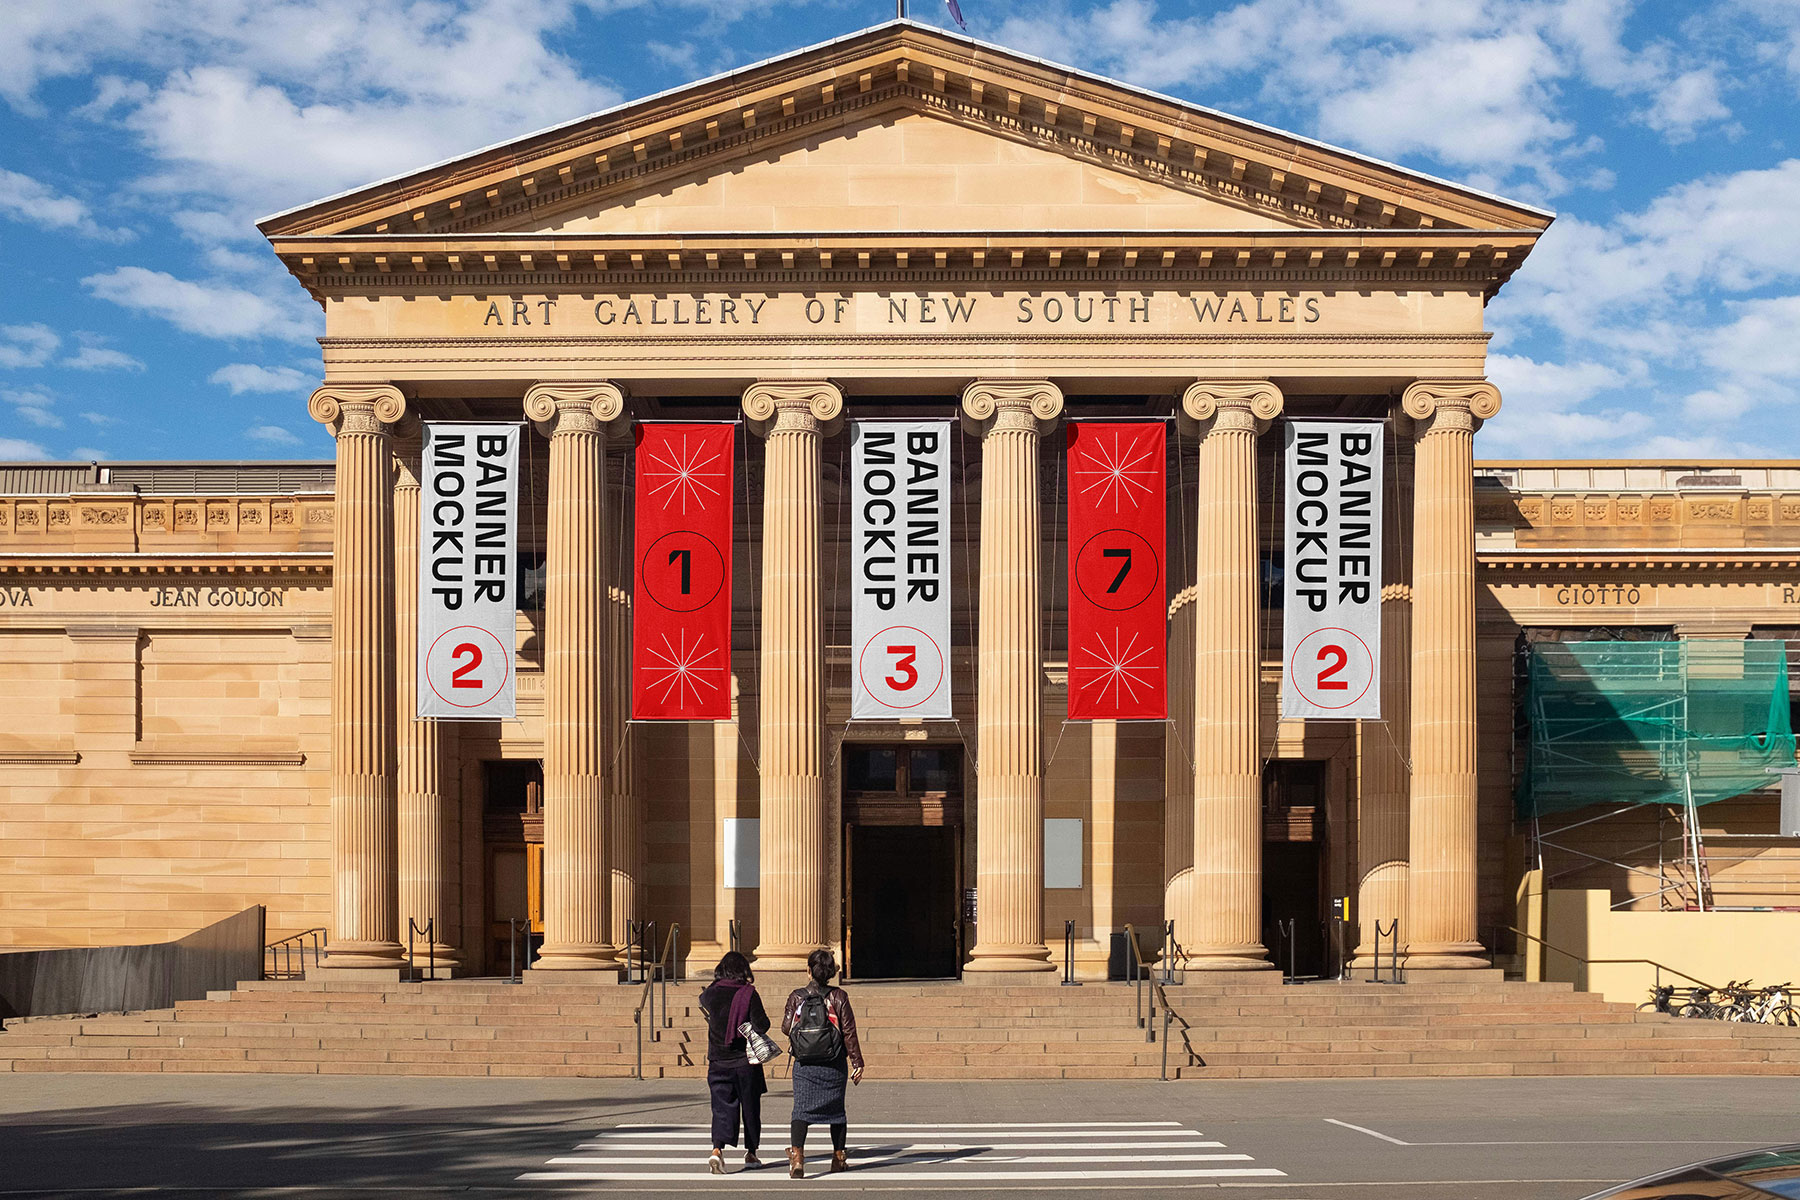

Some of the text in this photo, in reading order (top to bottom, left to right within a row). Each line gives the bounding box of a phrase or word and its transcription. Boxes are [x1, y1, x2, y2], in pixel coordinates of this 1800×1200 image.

[483, 298, 1320, 326] ART GALLERY OF NEW SOUTH WALES
[431, 434, 465, 611] MOCKUP
[474, 434, 508, 604] BANNER
[863, 431, 896, 611] MOCKUP
[907, 431, 939, 604] BANNER
[1295, 432, 1329, 613] MOCKUP
[1338, 432, 1372, 605] BANNER
[668, 550, 691, 595] 1
[1103, 548, 1132, 594] 7
[150, 591, 284, 607] JEAN GOUJON
[1557, 588, 1641, 605] GIOTTO
[1783, 587, 1800, 603] R
[451, 642, 483, 689] 2
[884, 645, 918, 691] 3
[1316, 644, 1348, 690] 2
